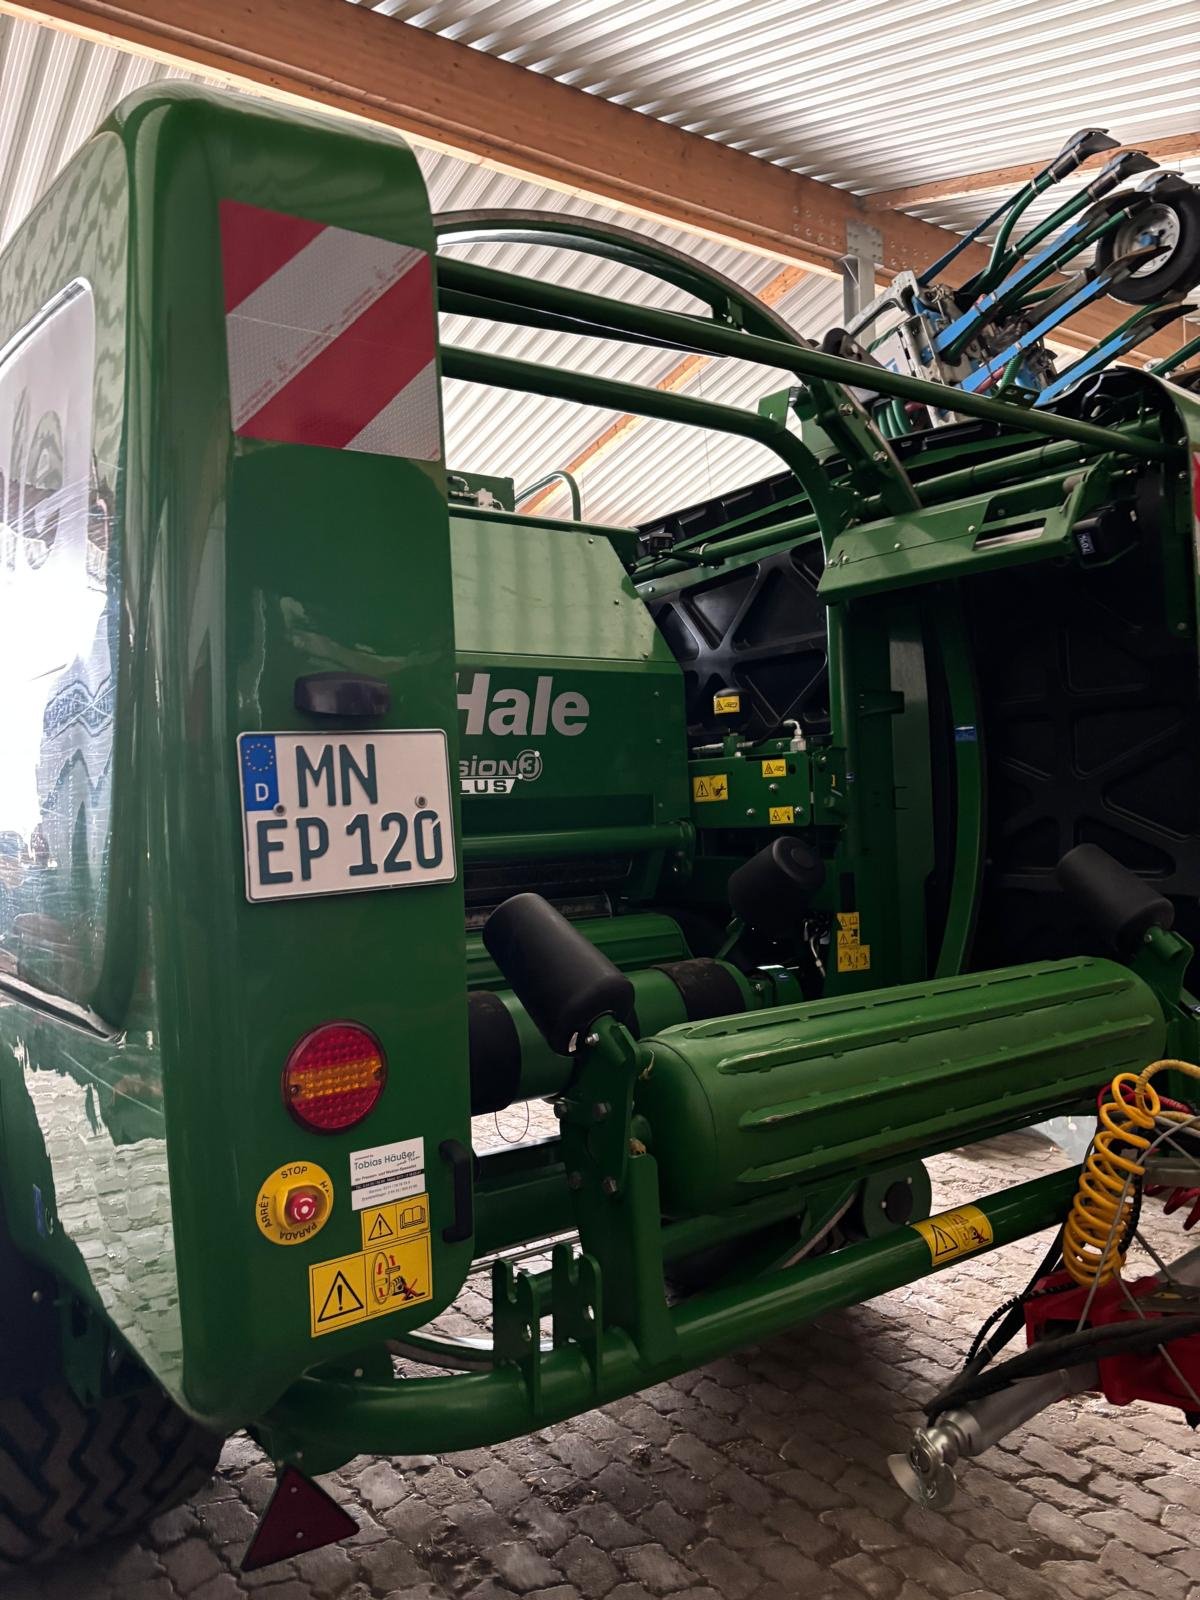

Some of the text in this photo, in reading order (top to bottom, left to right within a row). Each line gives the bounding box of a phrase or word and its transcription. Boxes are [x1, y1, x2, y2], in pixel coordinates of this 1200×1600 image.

[455, 672, 590, 737] Hale
[295, 743, 378, 808] MN
[255, 783, 269, 802] D
[256, 809, 443, 885] EP 120
[354, 1159, 382, 1170] Tobias
[384, 1150, 416, 1164] Häußer
[281, 1166, 308, 1179] STOP
[280, 1221, 318, 1241] PARADA
